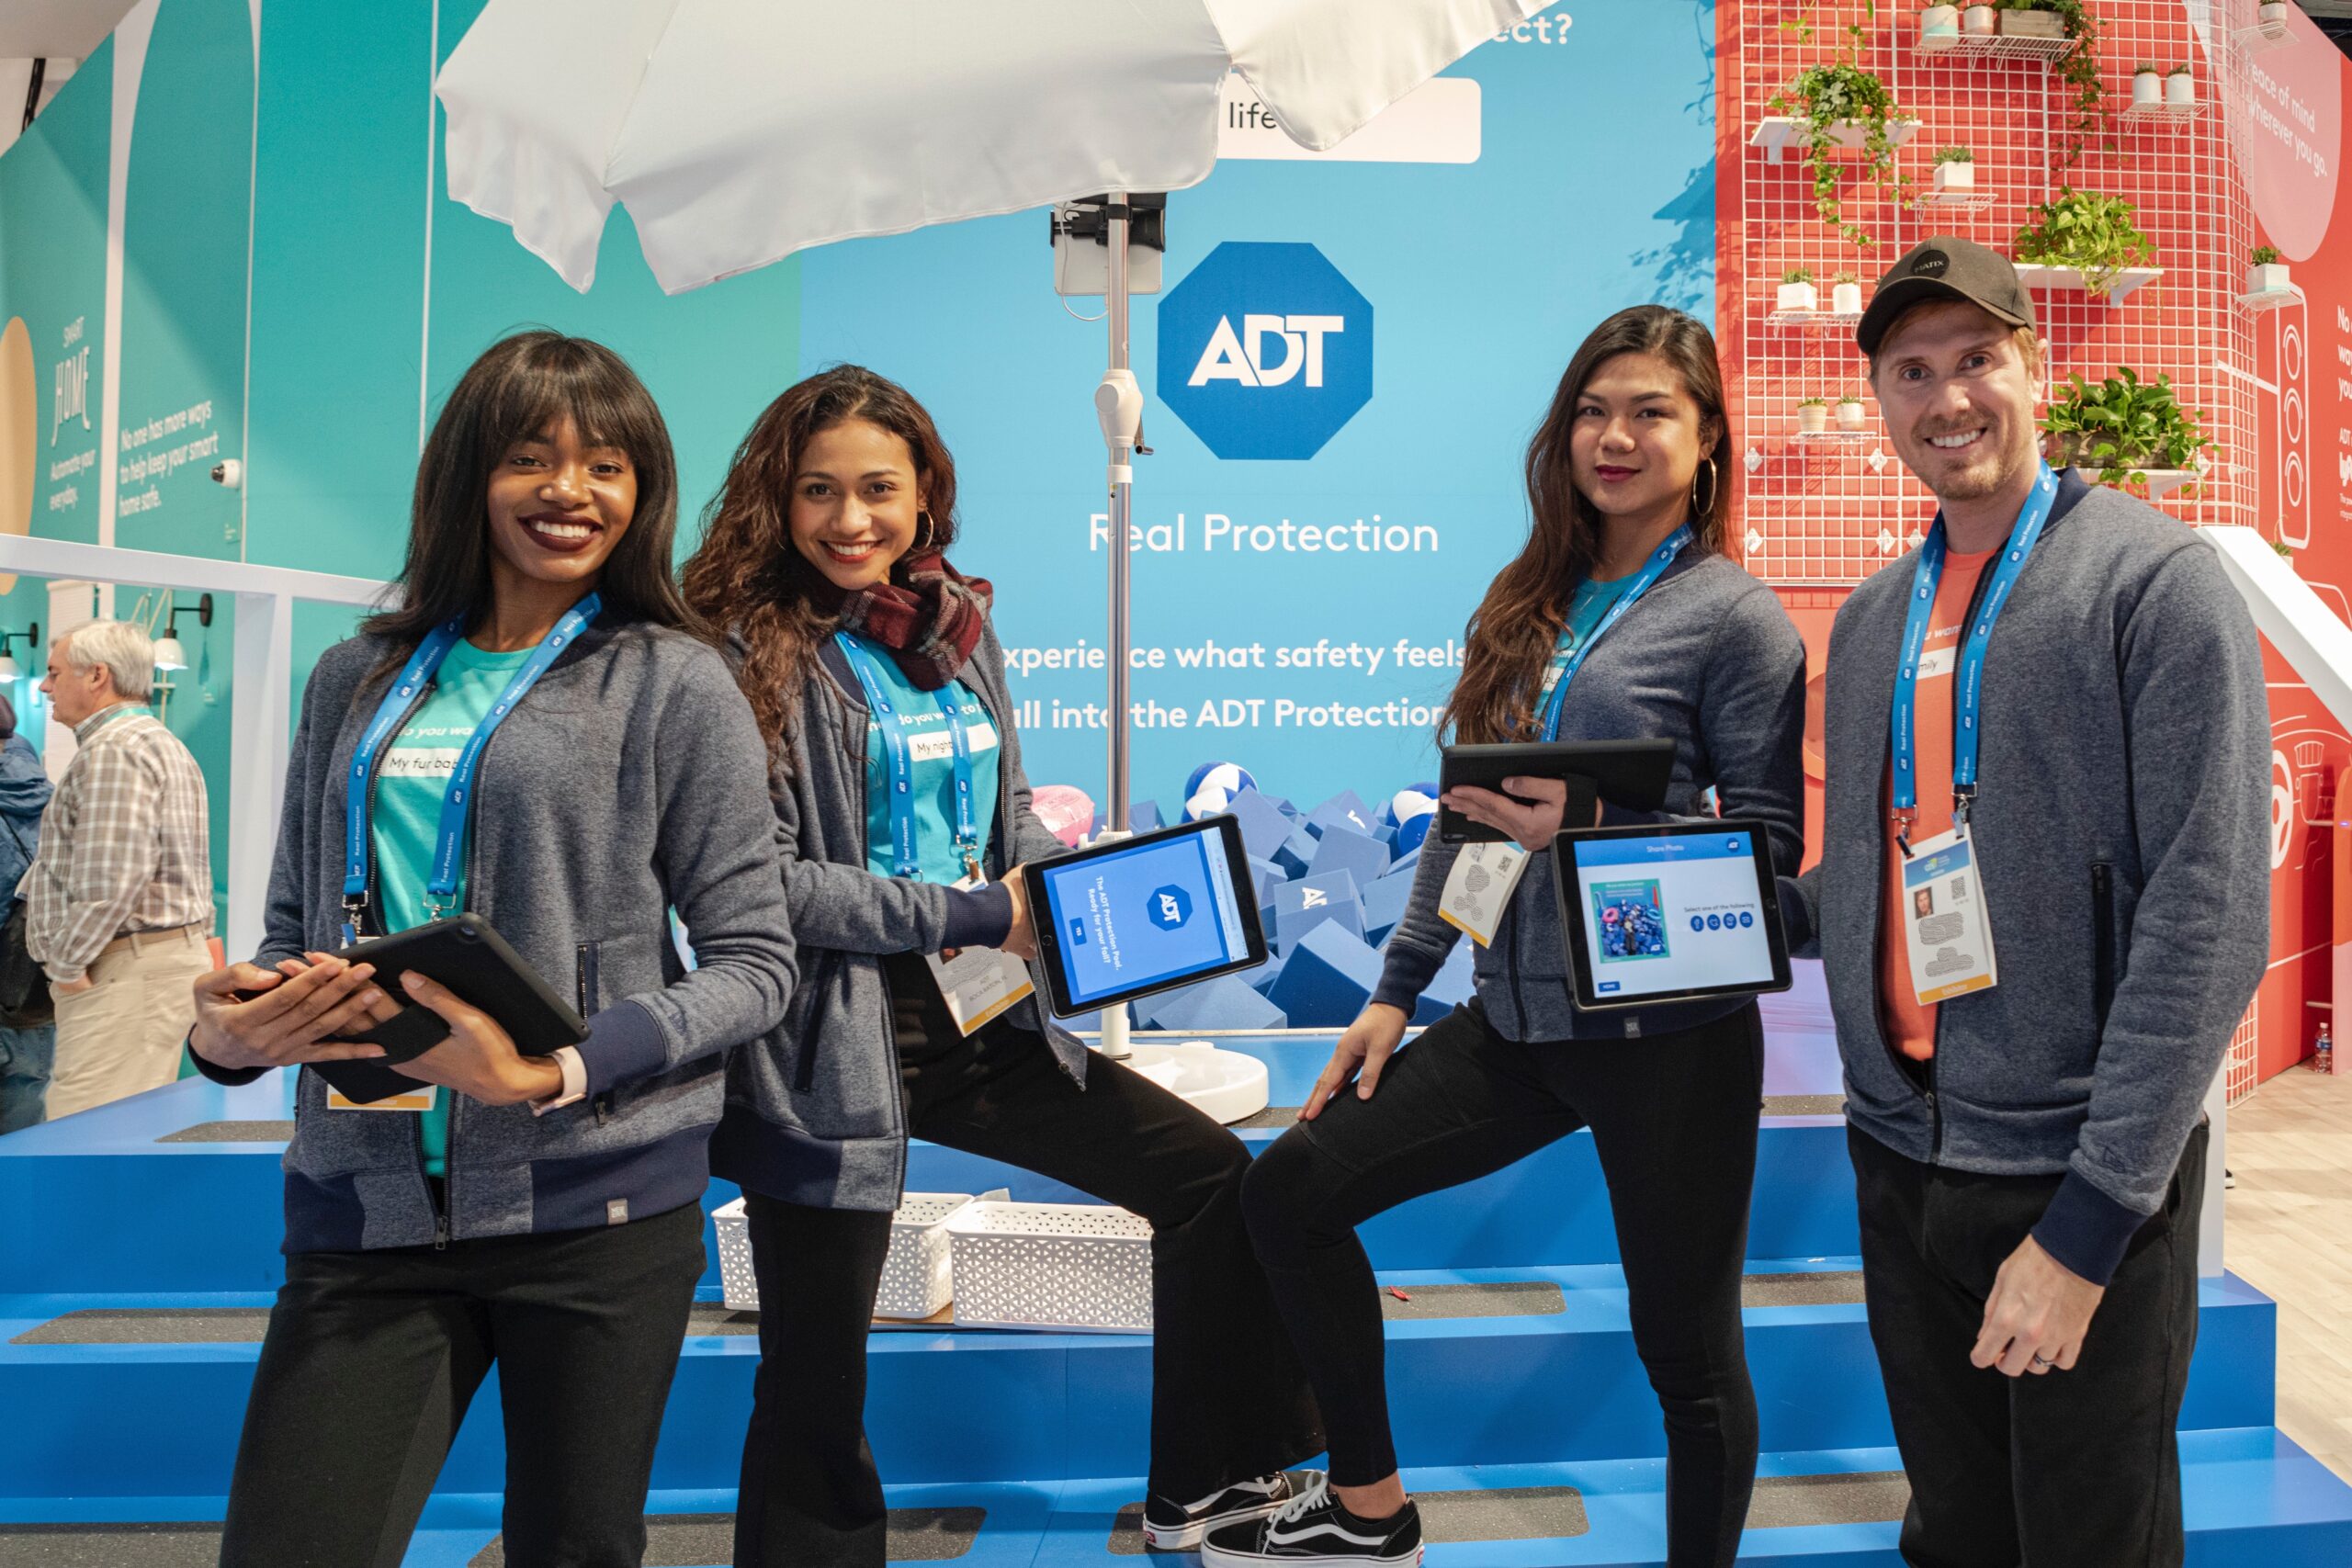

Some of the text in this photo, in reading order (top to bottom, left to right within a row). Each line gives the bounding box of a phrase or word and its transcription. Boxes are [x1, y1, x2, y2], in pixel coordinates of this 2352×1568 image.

[1229, 102, 1277, 129] life
[2278, 86, 2290, 109] of
[2291, 98, 2315, 133] mind
[2295, 135, 2312, 164] you
[2313, 152, 2327, 177] go.
[2337, 305, 2350, 333] No
[1186, 313, 1344, 387] ADT
[51, 345, 90, 447] HOME
[121, 400, 211, 452] No one has more ways
[2339, 427, 2351, 446] ADT
[79, 449, 96, 476] your
[120, 431, 219, 485] to help keep your smart
[119, 495, 140, 517] home
[1091, 513, 1439, 552] Real Protection
[1002, 638, 1465, 677] xperiece what safety feels
[961, 704, 976, 715] to
[1129, 700, 1187, 728] the
[1195, 700, 1265, 728] ADT
[1274, 697, 1447, 727] Protection
[414, 728, 447, 739] you
[917, 743, 931, 755] My
[390, 757, 409, 772] My
[413, 758, 432, 769] fur
[1095, 875, 1103, 891] The
[1100, 892, 1110, 908] ADT
[1159, 893, 1182, 923] ADT
[1088, 888, 1111, 964] Ready for your fall?
[1103, 908, 1117, 950] Protection
